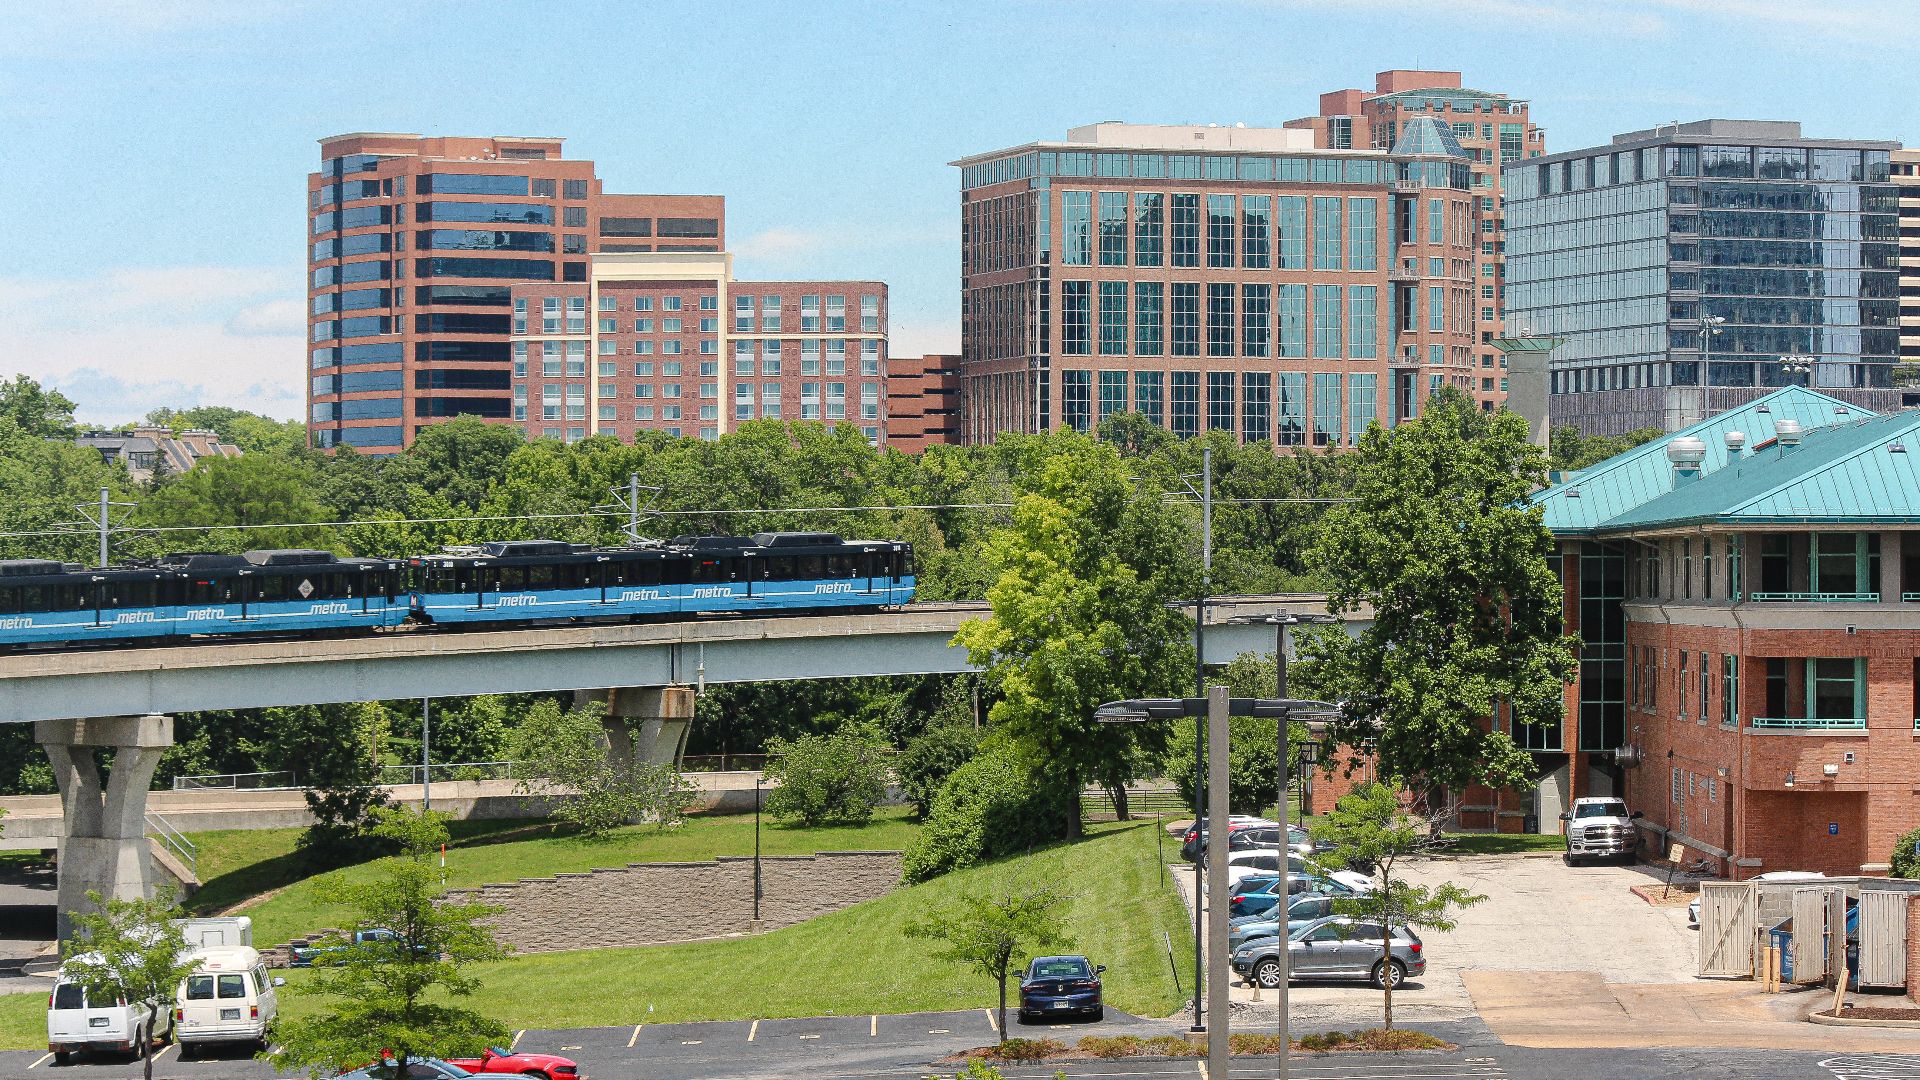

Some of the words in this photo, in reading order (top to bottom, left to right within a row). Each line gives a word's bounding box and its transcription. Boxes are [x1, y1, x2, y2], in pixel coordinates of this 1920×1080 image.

[693, 587, 731, 599] metro
[814, 582, 851, 594] metro
[499, 595, 537, 607] metro
[622, 589, 659, 601] metro
[186, 608, 224, 620] metro
[311, 602, 348, 614] metro
[117, 611, 154, 624] metro
